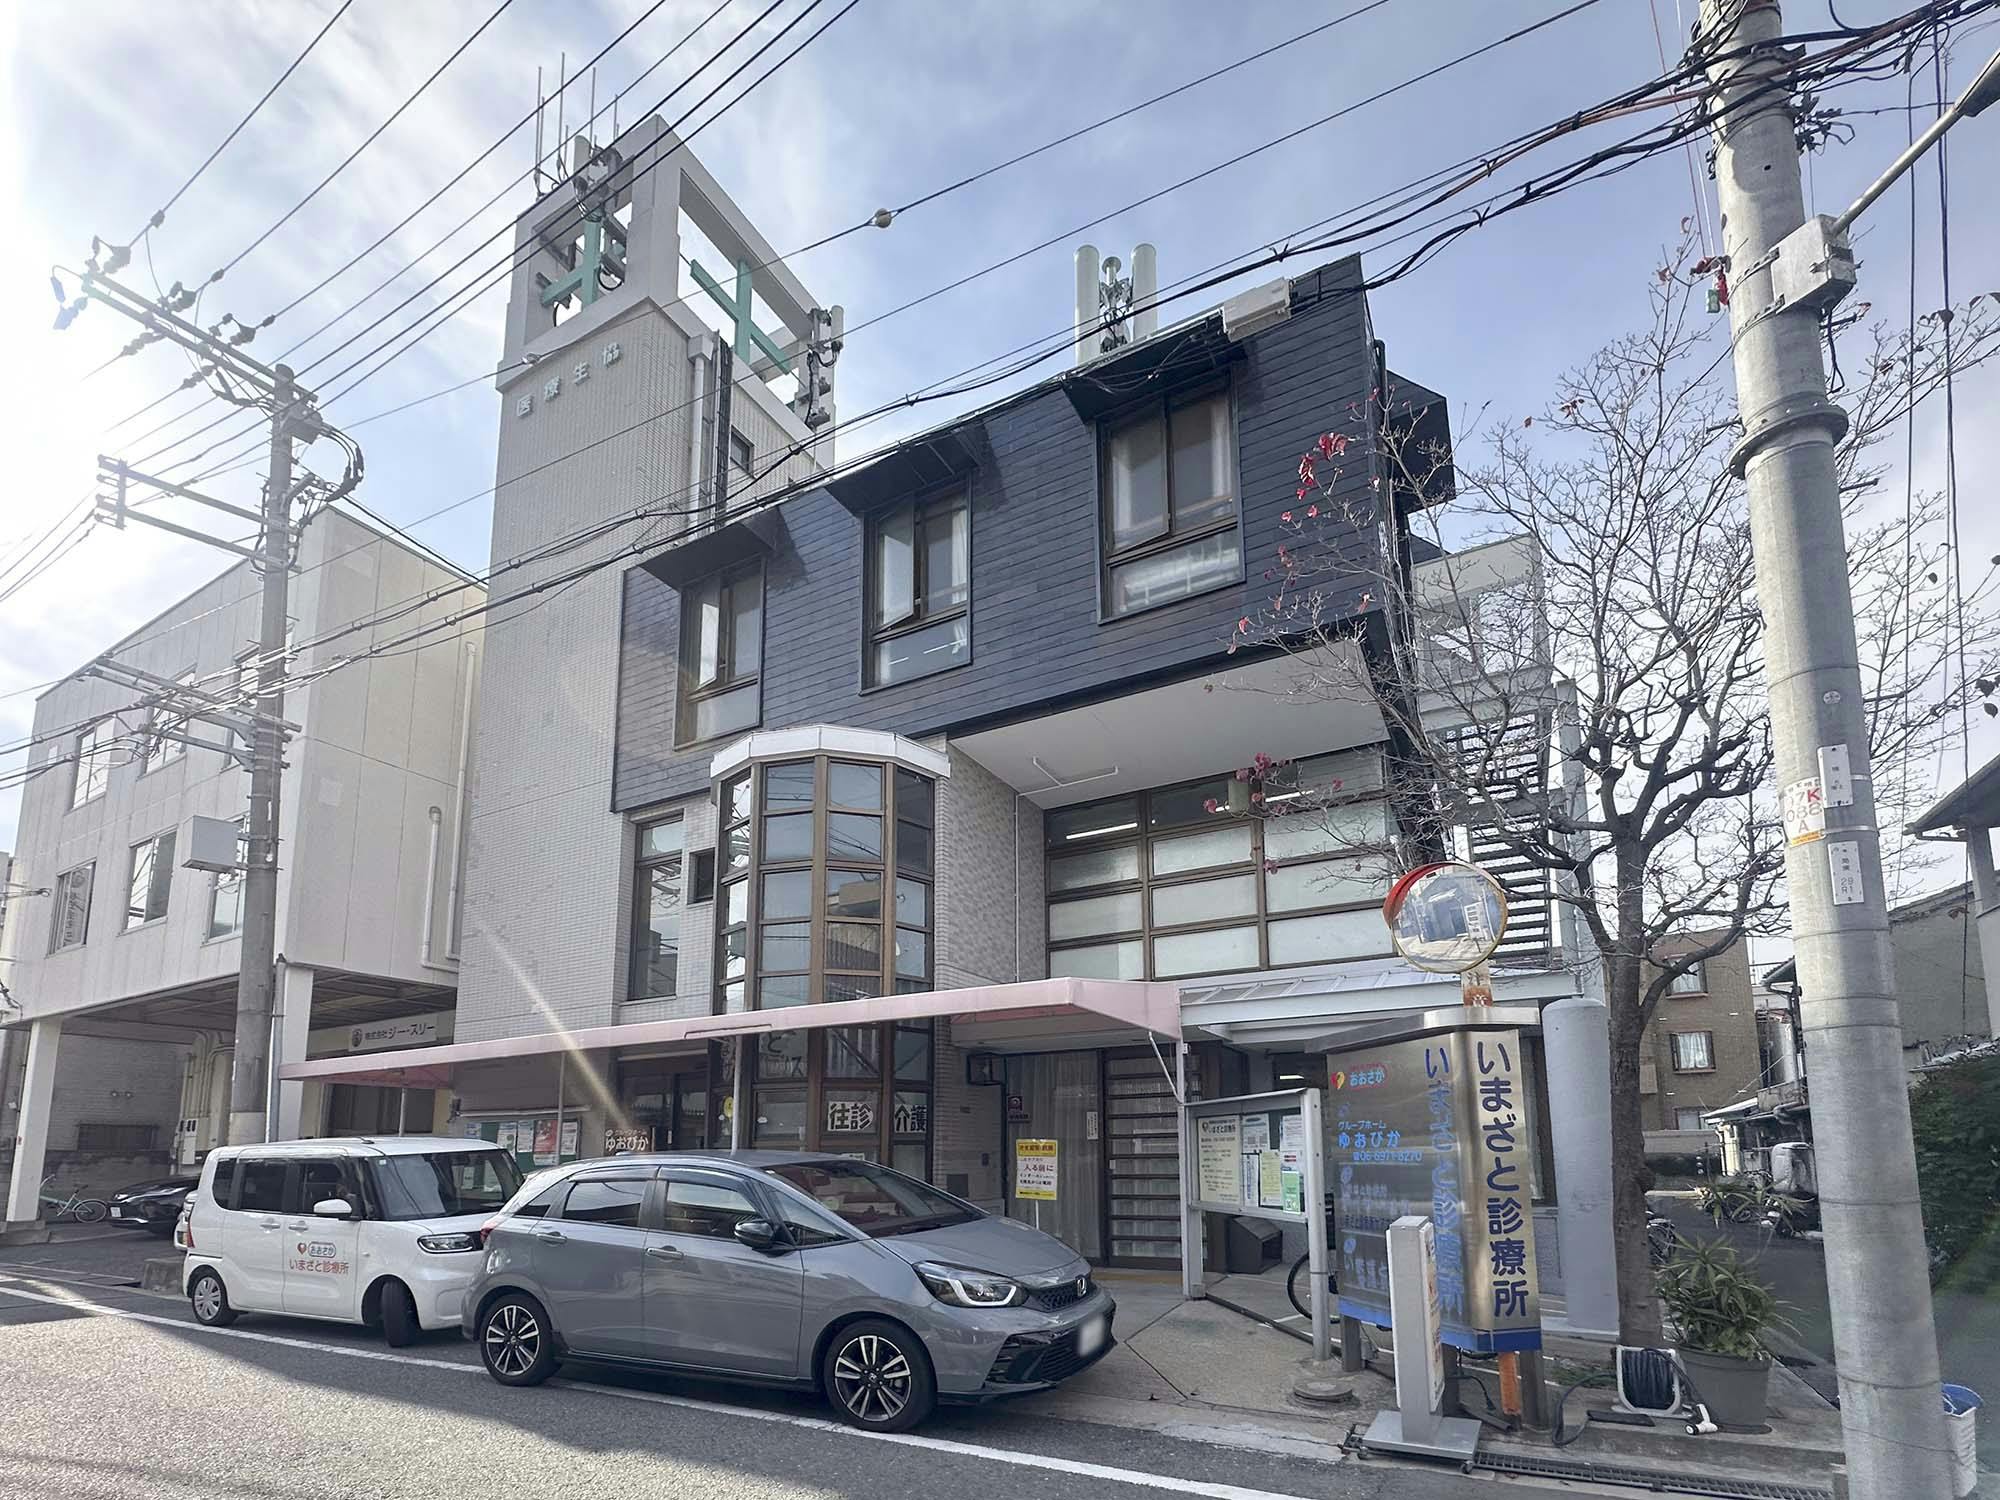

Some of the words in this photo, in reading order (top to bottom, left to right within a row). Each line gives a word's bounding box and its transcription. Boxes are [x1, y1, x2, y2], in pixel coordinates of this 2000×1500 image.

[516, 341, 623, 418] 医療生協
[1349, 1069, 1386, 1087] おおさか
[829, 1102, 873, 1131] 往診
[894, 1104, 928, 1132] 介護
[1338, 1120, 1387, 1131] グループホーム
[605, 1135, 649, 1152] ゆおびか
[1337, 1130, 1401, 1149] ゆおびか
[1476, 1040, 1529, 1317] いまざと診療所
[289, 1259, 350, 1275] いまざと診療所
